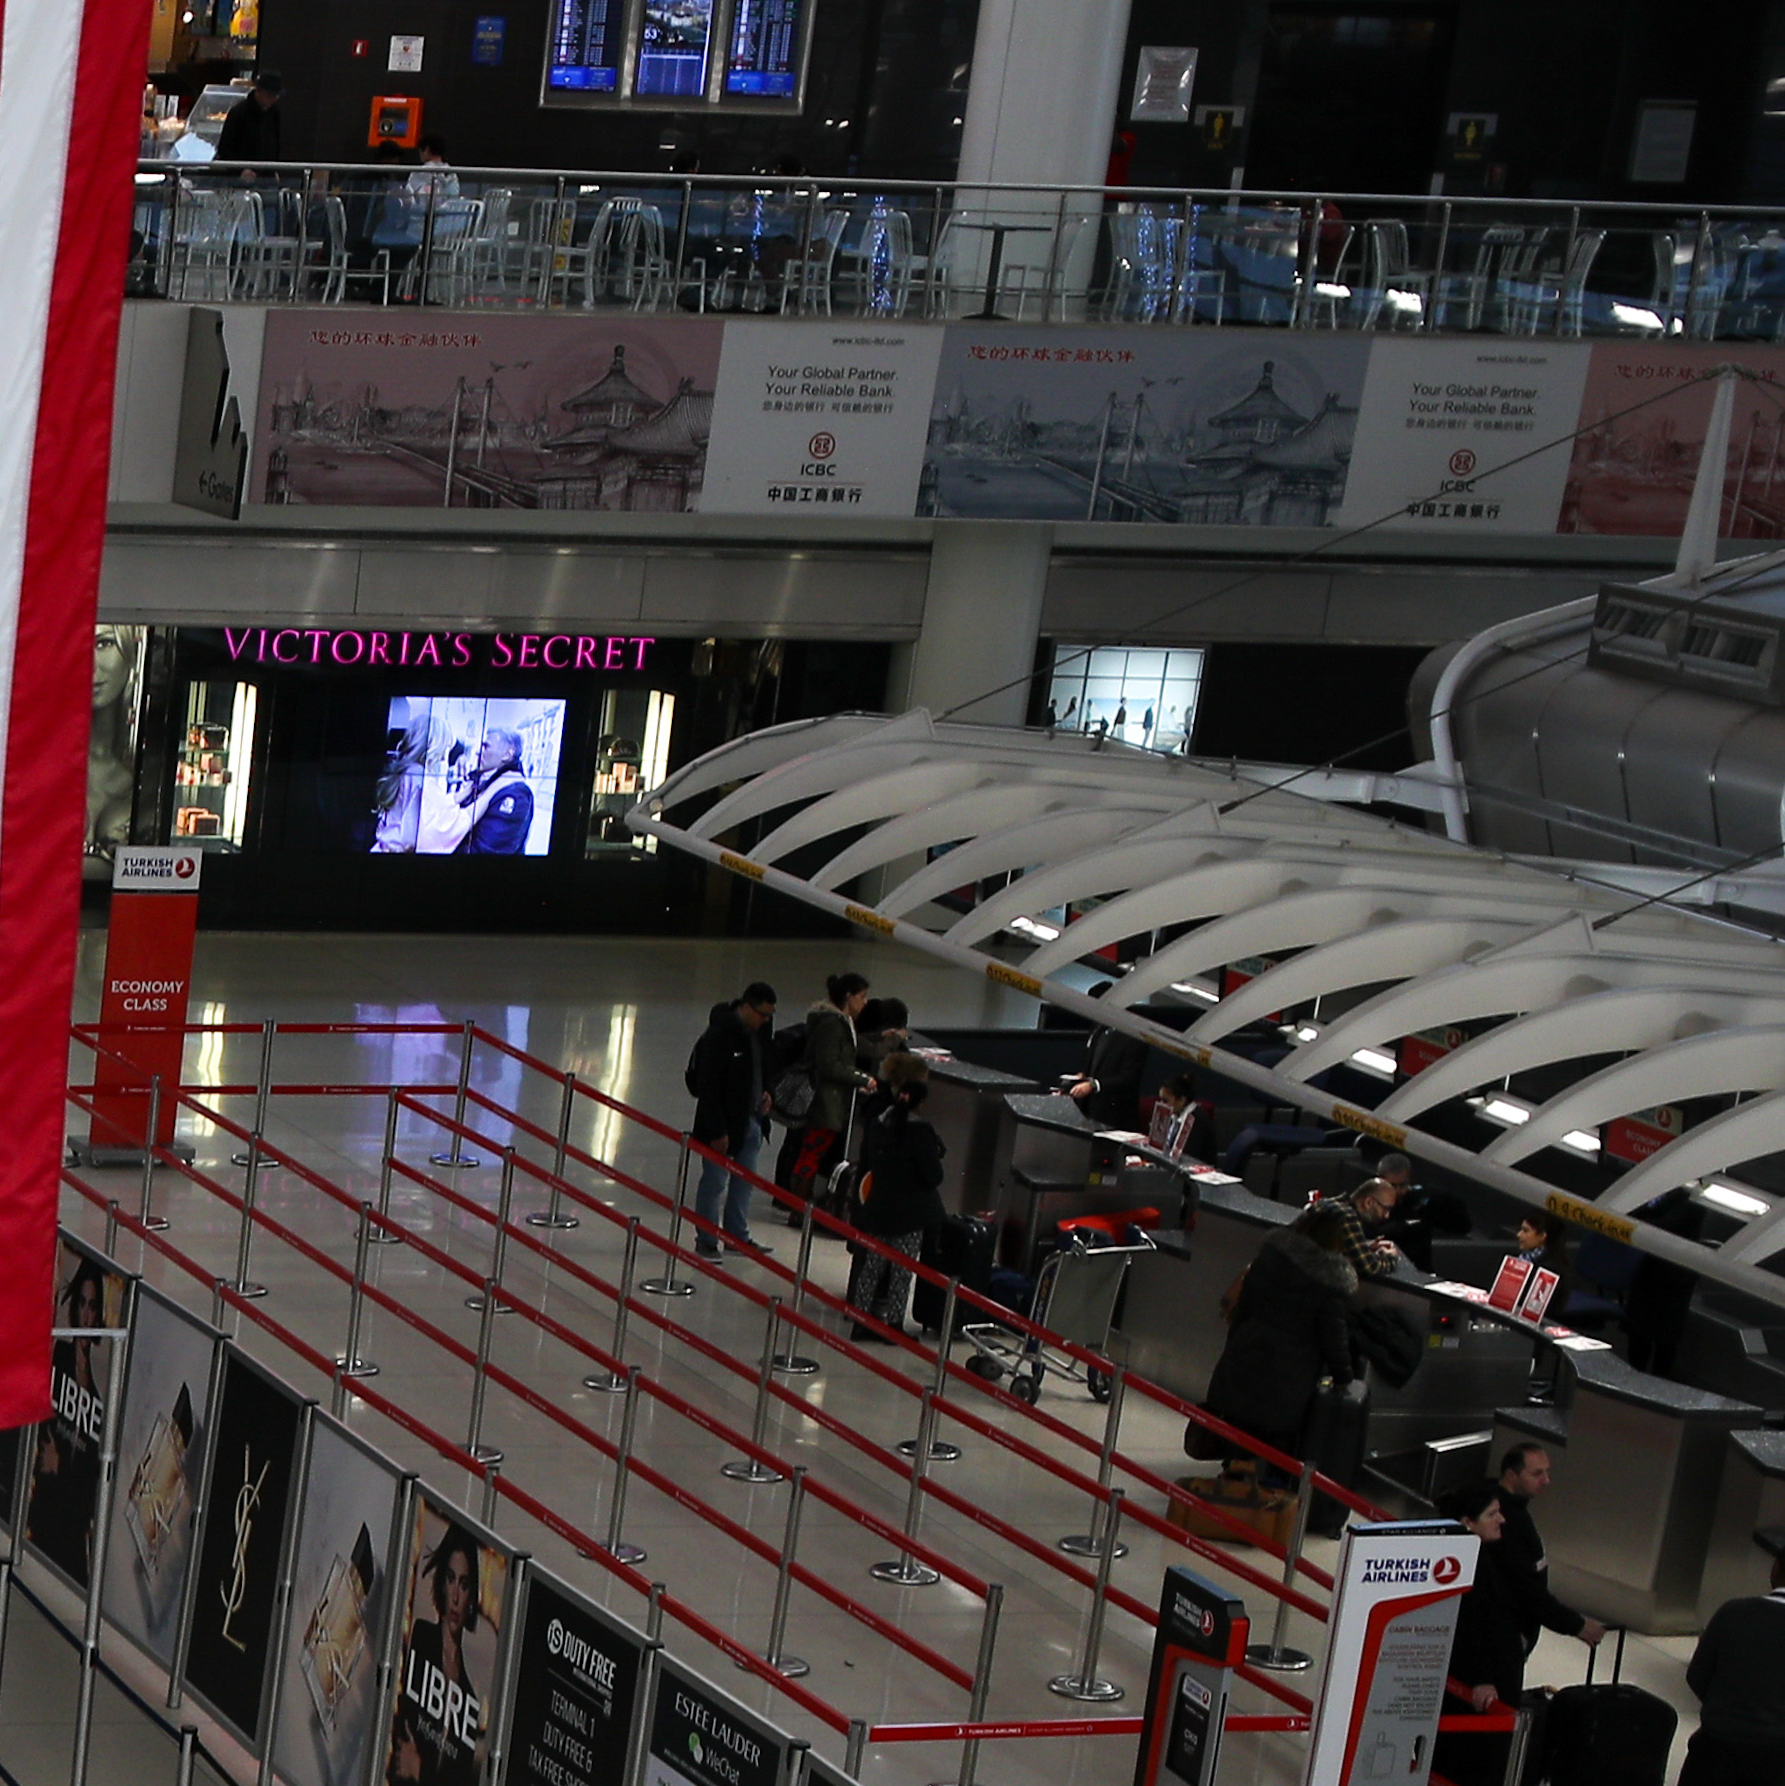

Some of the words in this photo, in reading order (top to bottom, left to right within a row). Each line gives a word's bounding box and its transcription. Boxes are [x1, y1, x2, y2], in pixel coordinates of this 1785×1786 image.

[768, 365, 798, 380] Your
[802, 367, 844, 381] Global
[848, 368, 898, 381] Partner.
[765, 383, 796, 397] Your
[799, 383, 856, 398] Reliable
[859, 384, 894, 398] Bank.
[1412, 383, 1443, 397] Your
[1445, 384, 1487, 398] Global
[1409, 400, 1442, 414] Your
[1443, 401, 1496, 415] Reliable
[800, 463, 836, 476] ICBC
[1440, 480, 1475, 492] ICBC
[767, 486, 863, 504] 中国工商银行
[1407, 502, 1501, 519] 中国工商银行
[224, 626, 473, 667] VICTORIA'S
[491, 631, 656, 671] SECRET
[124, 858, 174, 868] TURKISH
[121, 868, 173, 878] AIRLINES
[111, 980, 185, 994] ECONOMY
[123, 998, 168, 1011] CLASS
[49, 1364, 104, 1442] LIBRE
[1365, 1558, 1430, 1570] TURKISH
[1361, 1571, 1429, 1583] AIRLINES
[562, 1630, 591, 1671] DUTY
[589, 1648, 618, 1690] FREE
[405, 1648, 481, 1751] LIBRE
[551, 1689, 588, 1736] TERMINAL
[542, 1720, 565, 1753] DUTY
[564, 1736, 588, 1769] FREE
[711, 1716, 762, 1767] LAUDER
[528, 1743, 545, 1775] TAX
[705, 1746, 740, 1786] WeChat
